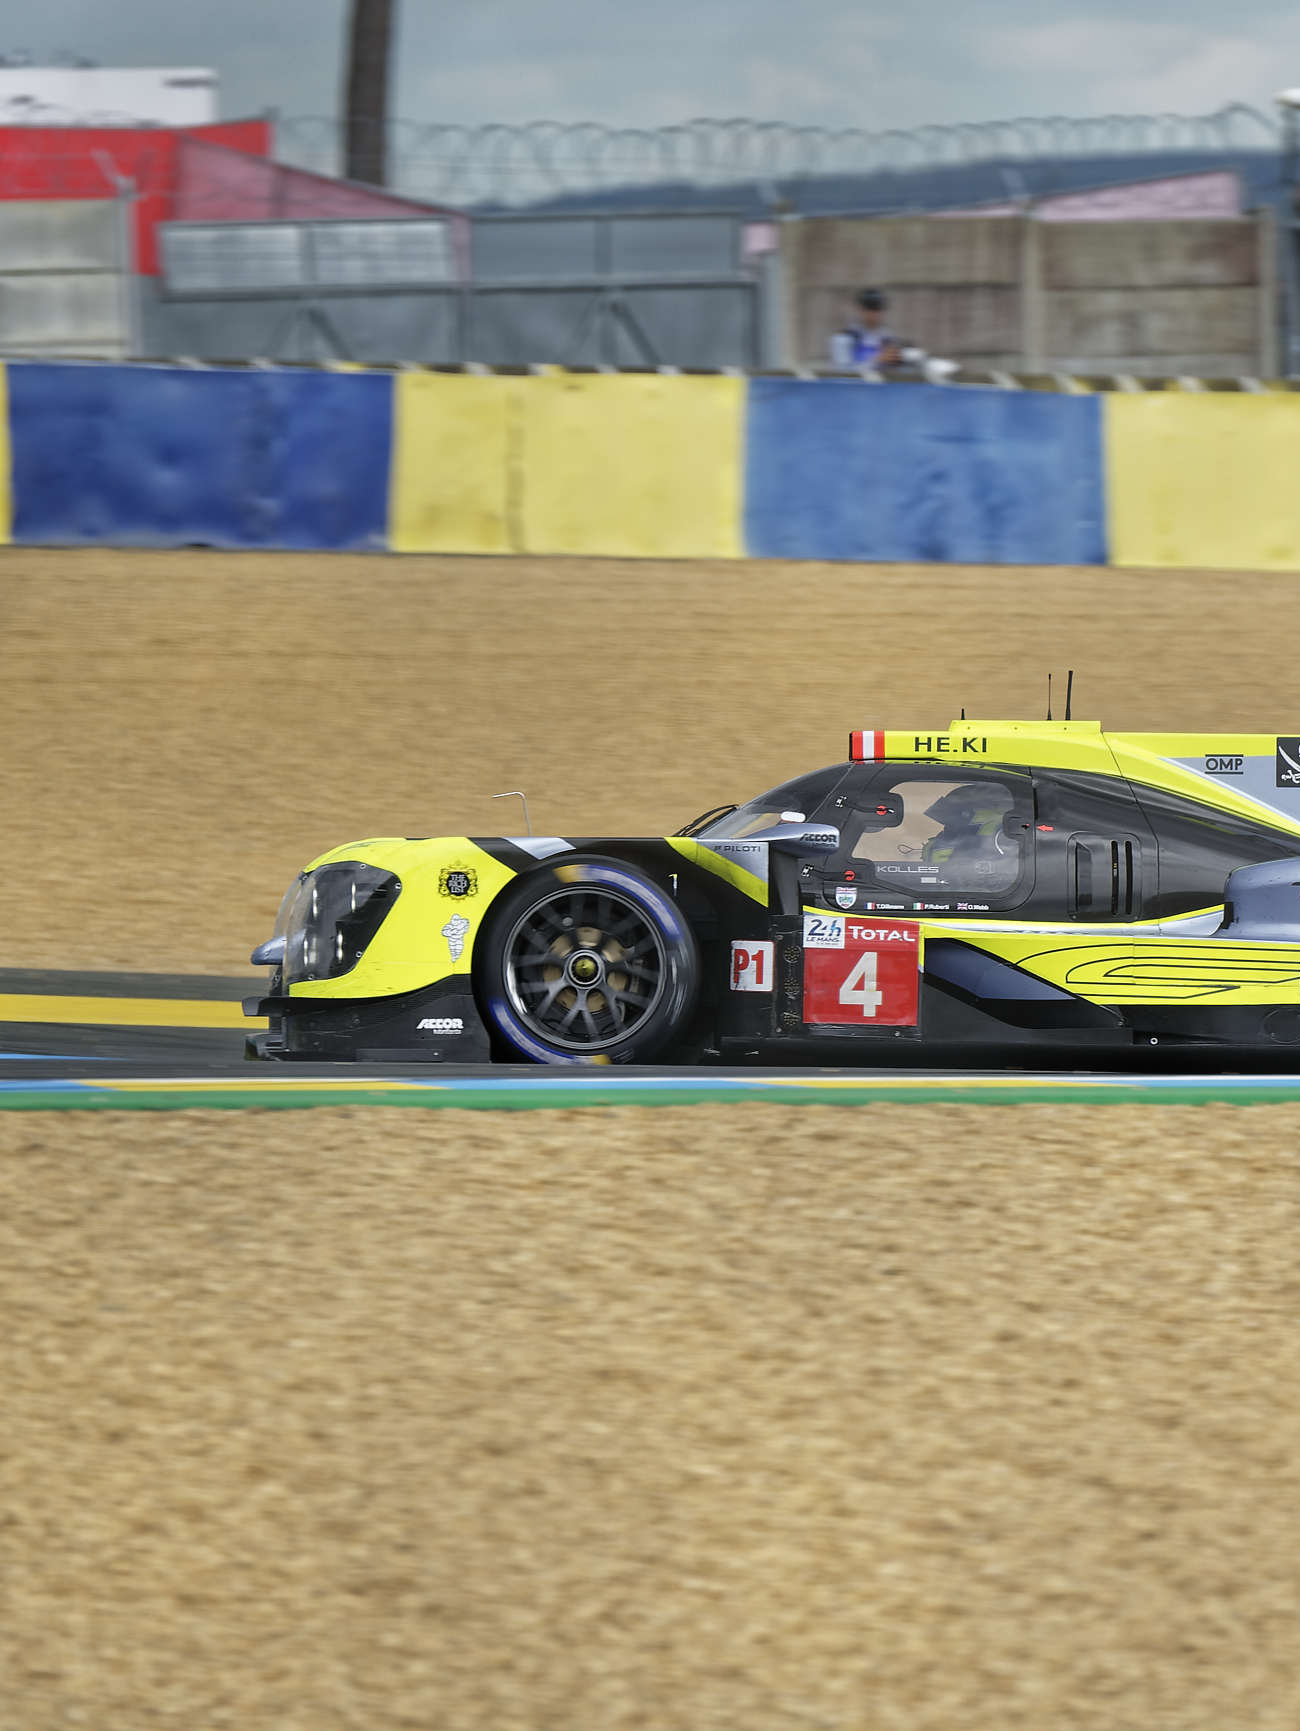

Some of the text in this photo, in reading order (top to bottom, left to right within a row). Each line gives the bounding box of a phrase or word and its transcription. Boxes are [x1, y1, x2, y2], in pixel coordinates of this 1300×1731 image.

[914, 736, 987, 753] HE.KI
[1205, 757, 1243, 771] OMP
[723, 845, 761, 853] PILOTI
[876, 865, 939, 873] KOLLES
[807, 919, 842, 936] 24h
[847, 925, 916, 942] TOTAL
[733, 948, 764, 985] P1
[838, 951, 883, 1018] 4
